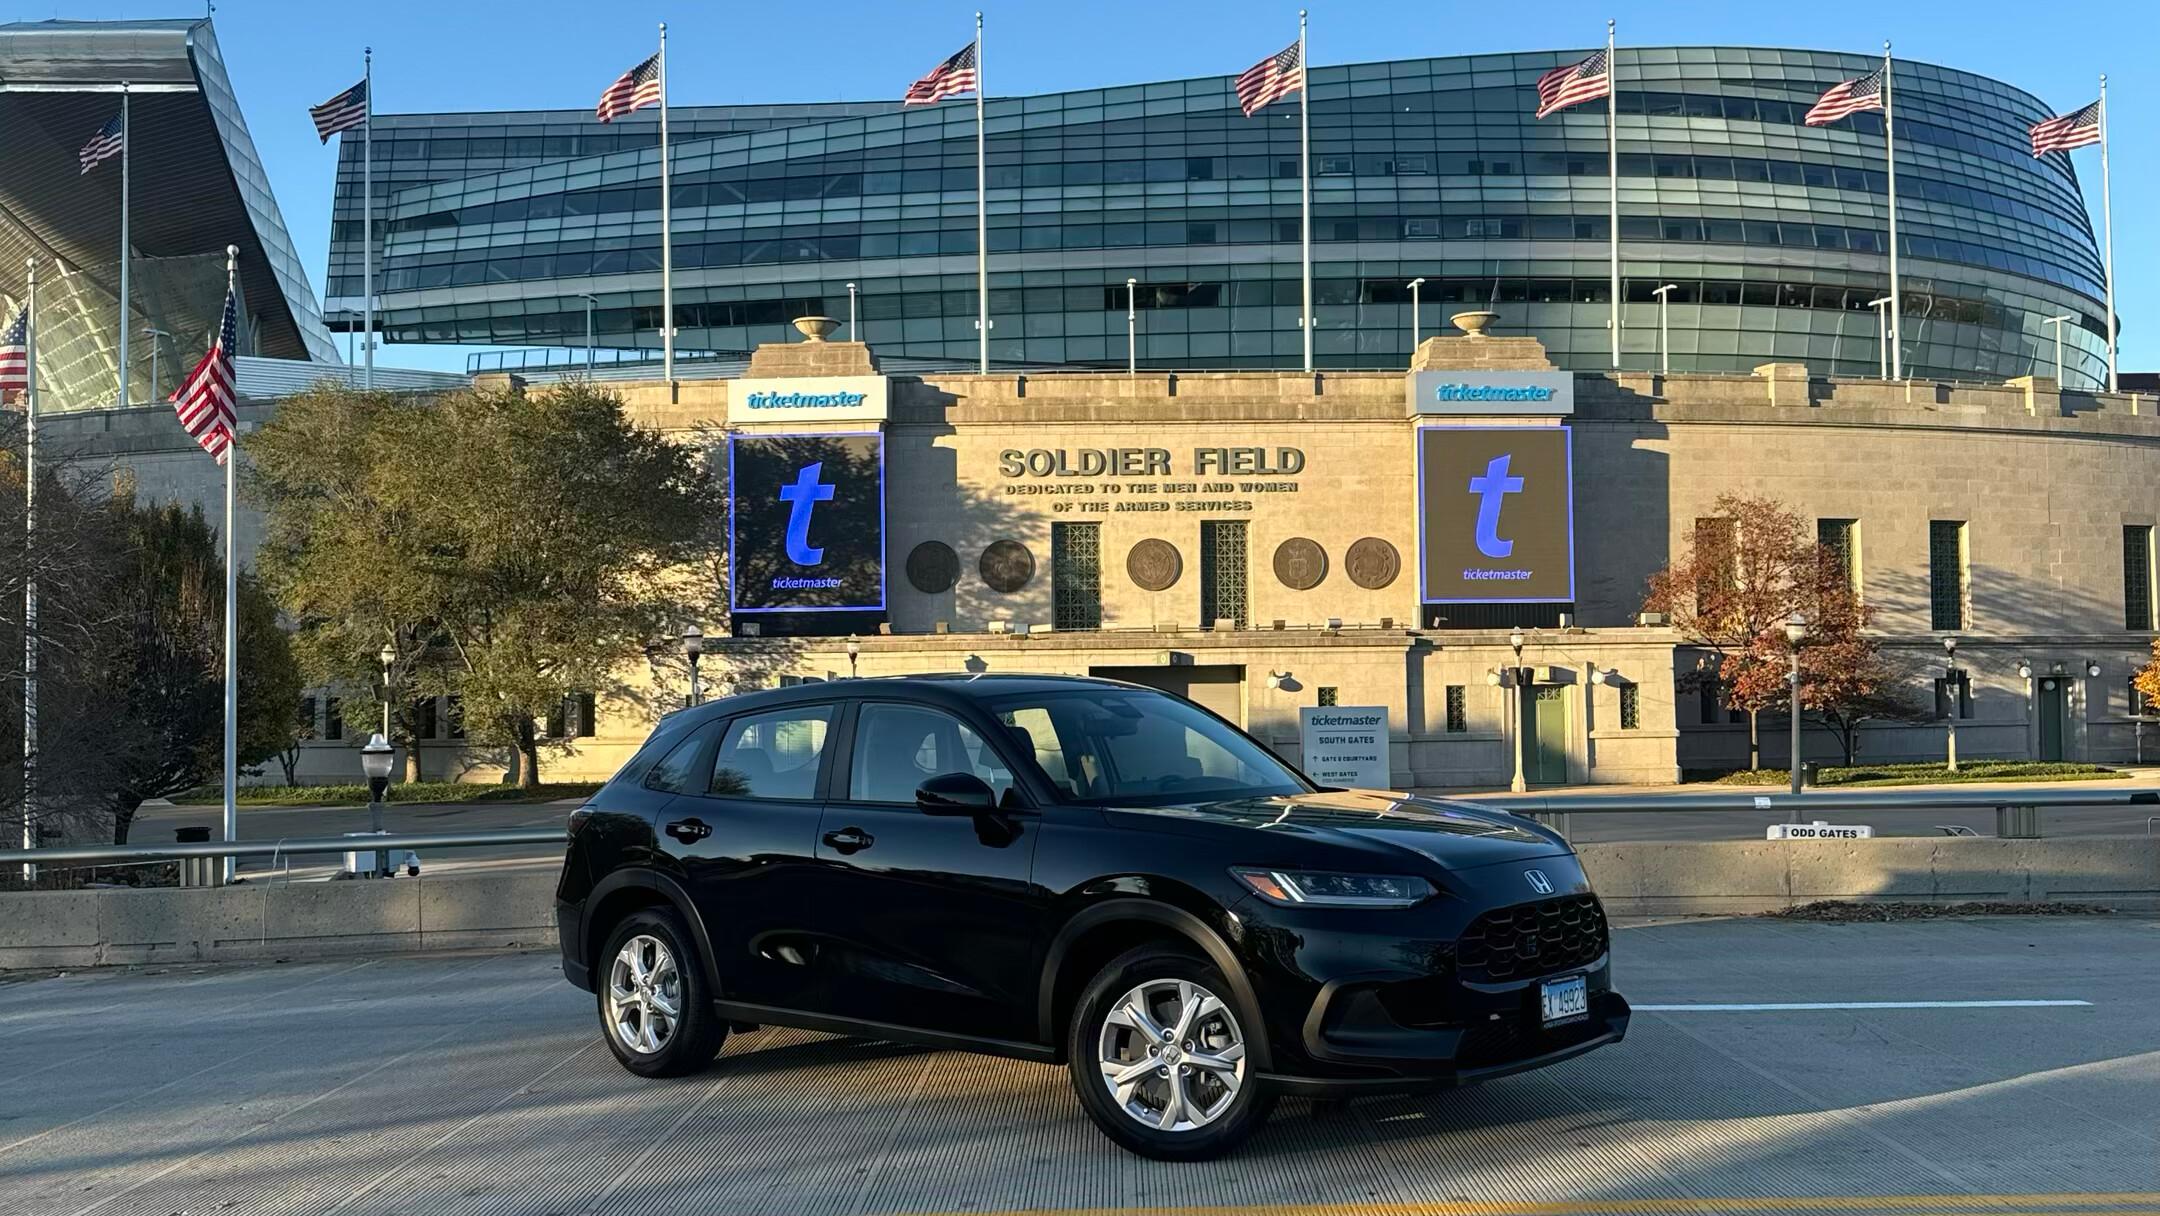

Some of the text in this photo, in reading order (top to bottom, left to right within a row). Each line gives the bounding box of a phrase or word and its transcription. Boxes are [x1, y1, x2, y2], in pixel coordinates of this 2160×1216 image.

[1436, 383, 1557, 401] ticketmaster
[747, 391, 867, 409] ticketmaster
[999, 446, 1305, 477] SOLDIER FIELD
[1005, 482, 1298, 495] DEDICATED TO THE MEN AND WOMEN
[1052, 501, 1253, 512] OF THE ARMED SERVICES
[1469, 454, 1524, 558] t
[779, 461, 836, 566] t
[1463, 568, 1533, 580] ticketmaster
[772, 576, 843, 589] ticketmaster
[1311, 714, 1381, 726] ticketmaster
[1319, 736, 1375, 744] SOUTH GATES
[1791, 828, 1857, 838] ODD GATES
[1559, 986, 1586, 1014] 49923
